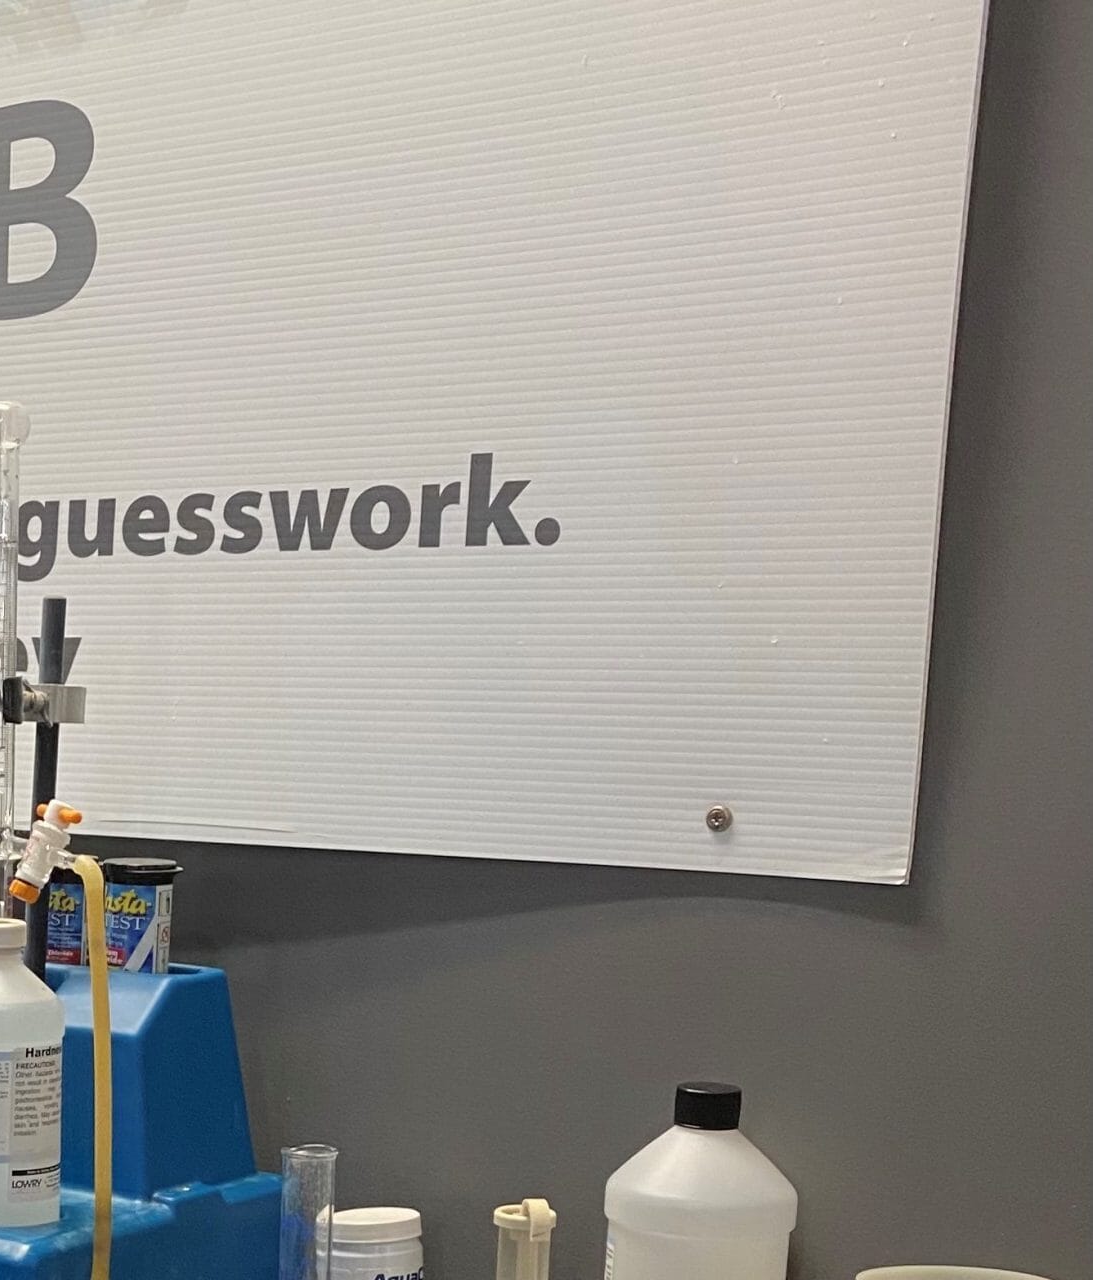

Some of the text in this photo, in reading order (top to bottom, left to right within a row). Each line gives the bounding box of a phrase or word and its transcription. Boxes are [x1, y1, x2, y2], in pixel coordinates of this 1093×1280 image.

[16, 452, 562, 583] guesswork.
[48, 912, 74, 926] ST
[25, 1044, 62, 1059] Hardn
